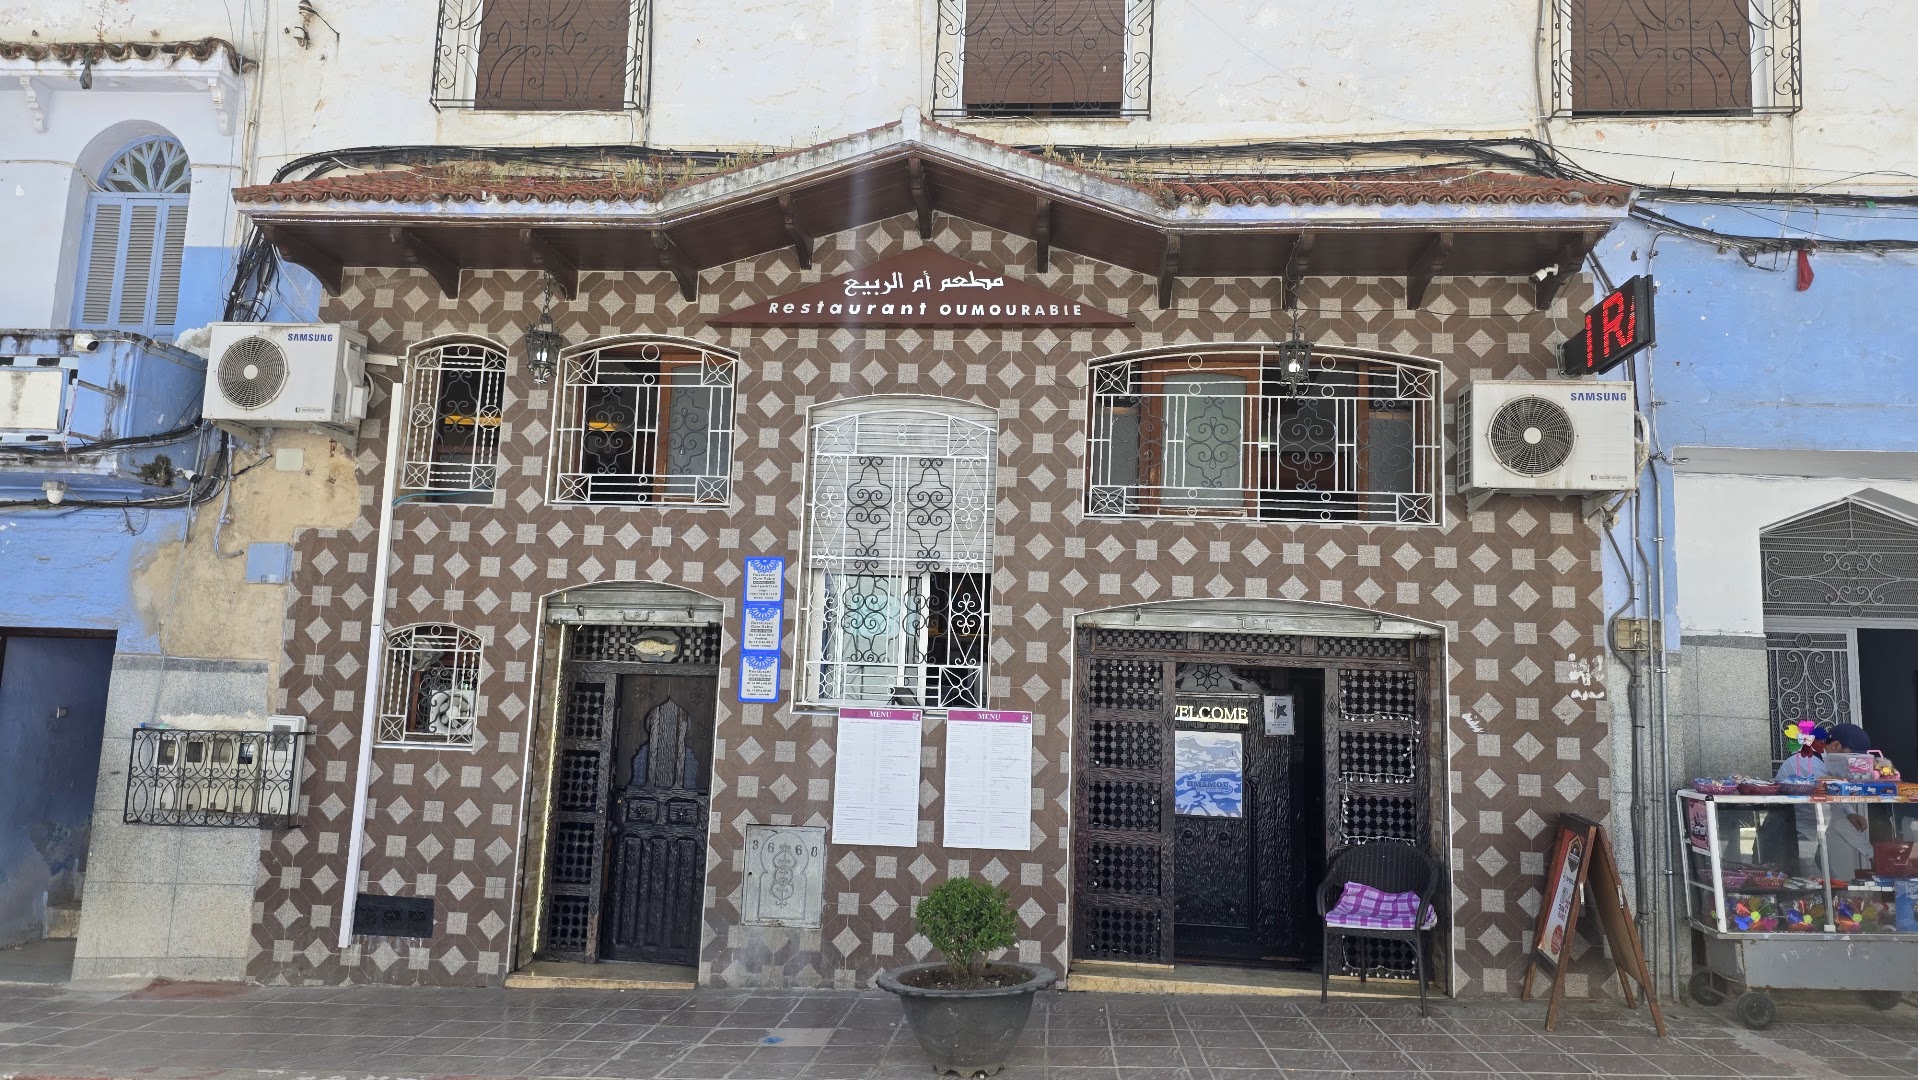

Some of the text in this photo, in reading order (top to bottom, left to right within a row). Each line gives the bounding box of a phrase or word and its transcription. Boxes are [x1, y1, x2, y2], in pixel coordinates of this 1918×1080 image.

[843, 270, 1004, 297] مطعم أم الربيع
[768, 300, 1082, 317] Restaurant OUMOURABIE
[287, 333, 333, 342] SAMSUNG
[1570, 392, 1627, 402] SAMSUNG
[868, 710, 892, 718] MENU
[977, 713, 1001, 721] MENU
